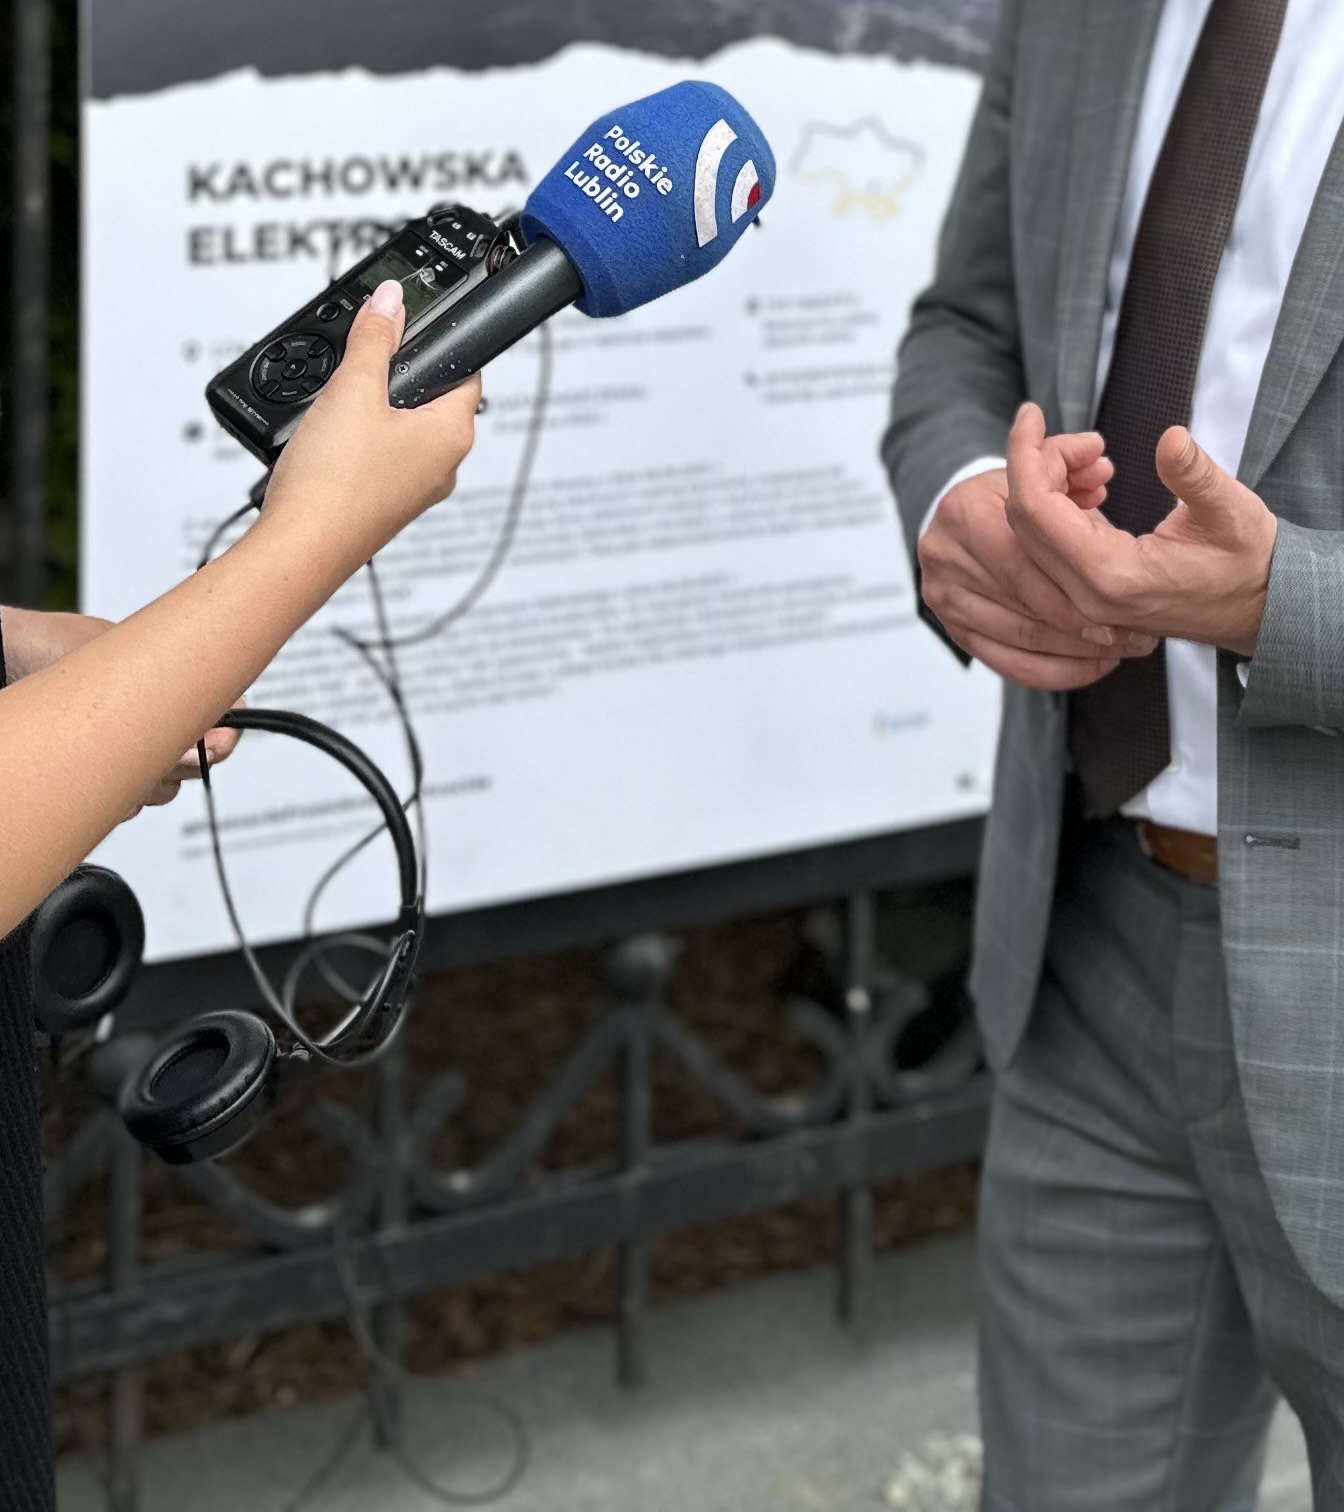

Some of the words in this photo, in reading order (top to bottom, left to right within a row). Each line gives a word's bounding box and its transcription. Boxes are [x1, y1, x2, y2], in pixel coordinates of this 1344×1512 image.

[187, 150, 528, 203] KACHOWSKA
[582, 142, 640, 199] Radio
[602, 124, 673, 196] Polskie
[564, 160, 625, 223] Lublin
[429, 229, 467, 260] TASCAM
